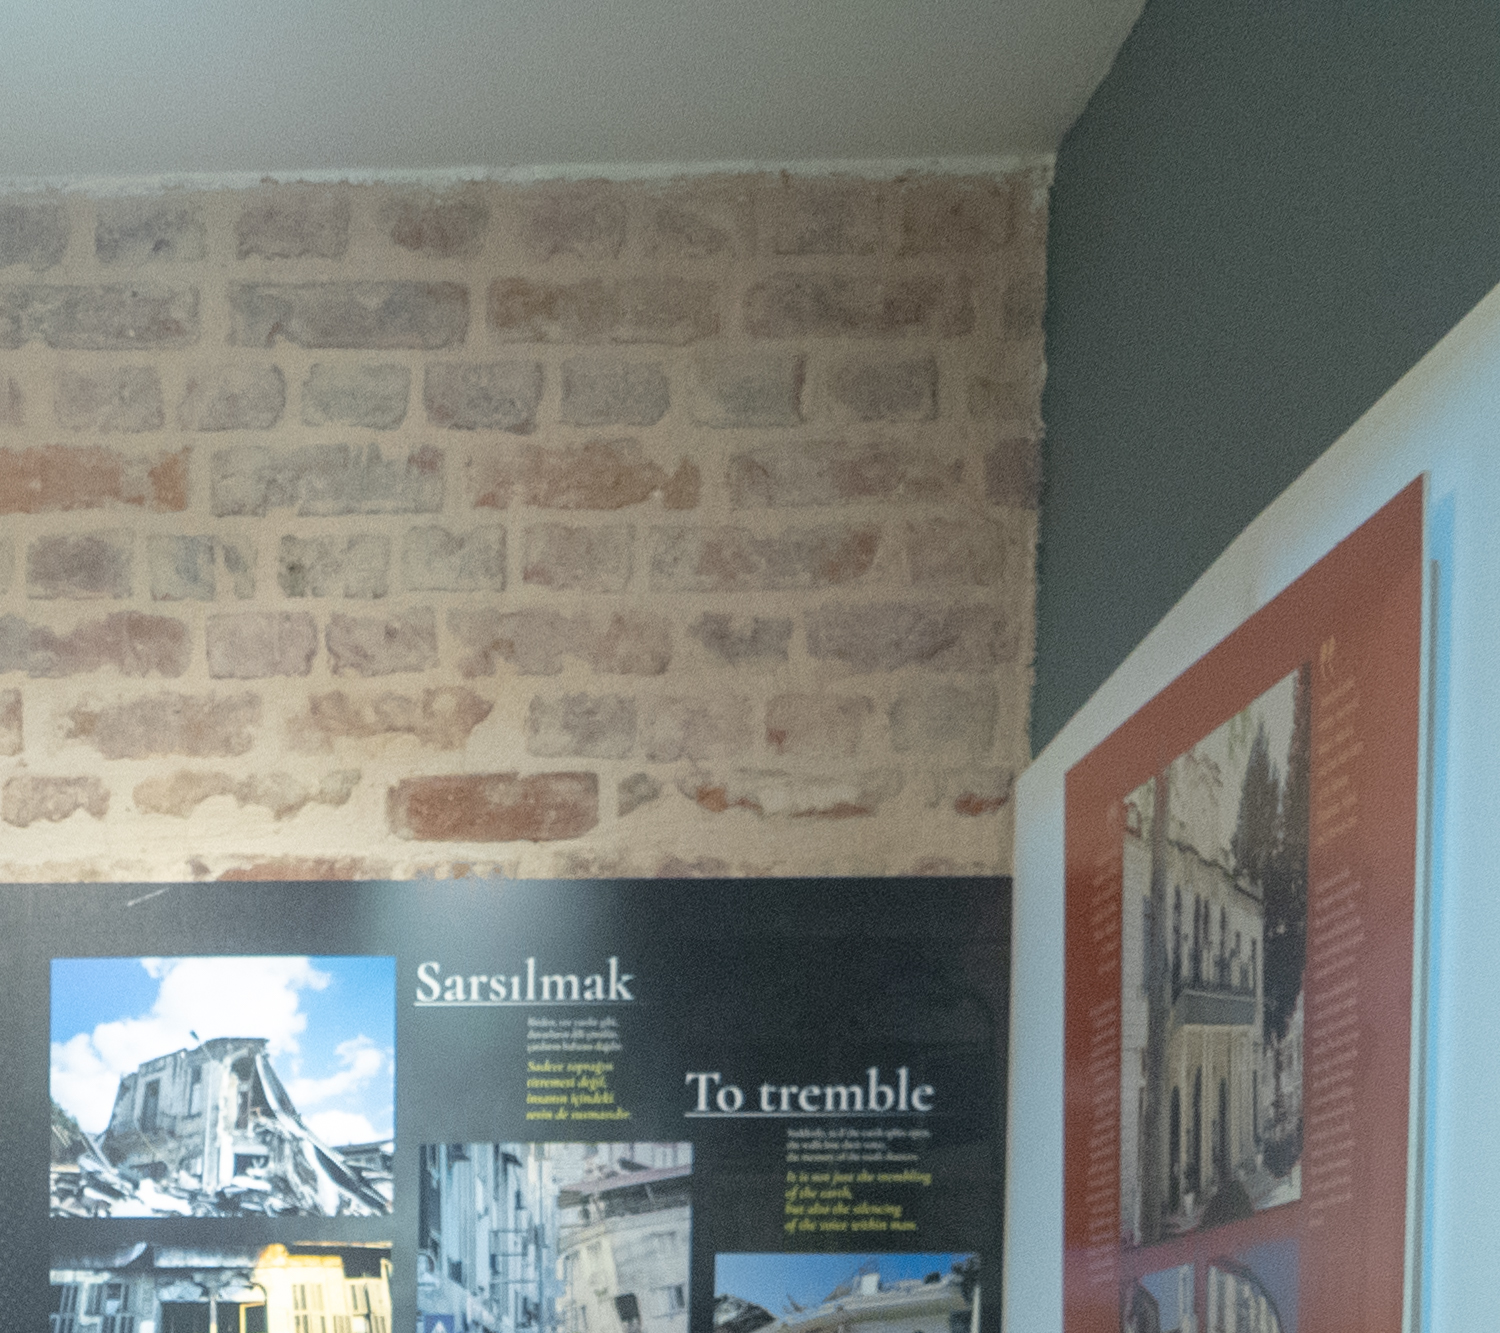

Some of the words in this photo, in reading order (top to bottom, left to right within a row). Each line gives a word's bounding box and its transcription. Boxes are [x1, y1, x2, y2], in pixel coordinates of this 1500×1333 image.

[415, 956, 636, 1002] Sarsılmak
[684, 1070, 746, 1113] To
[759, 1066, 937, 1113] tremble
